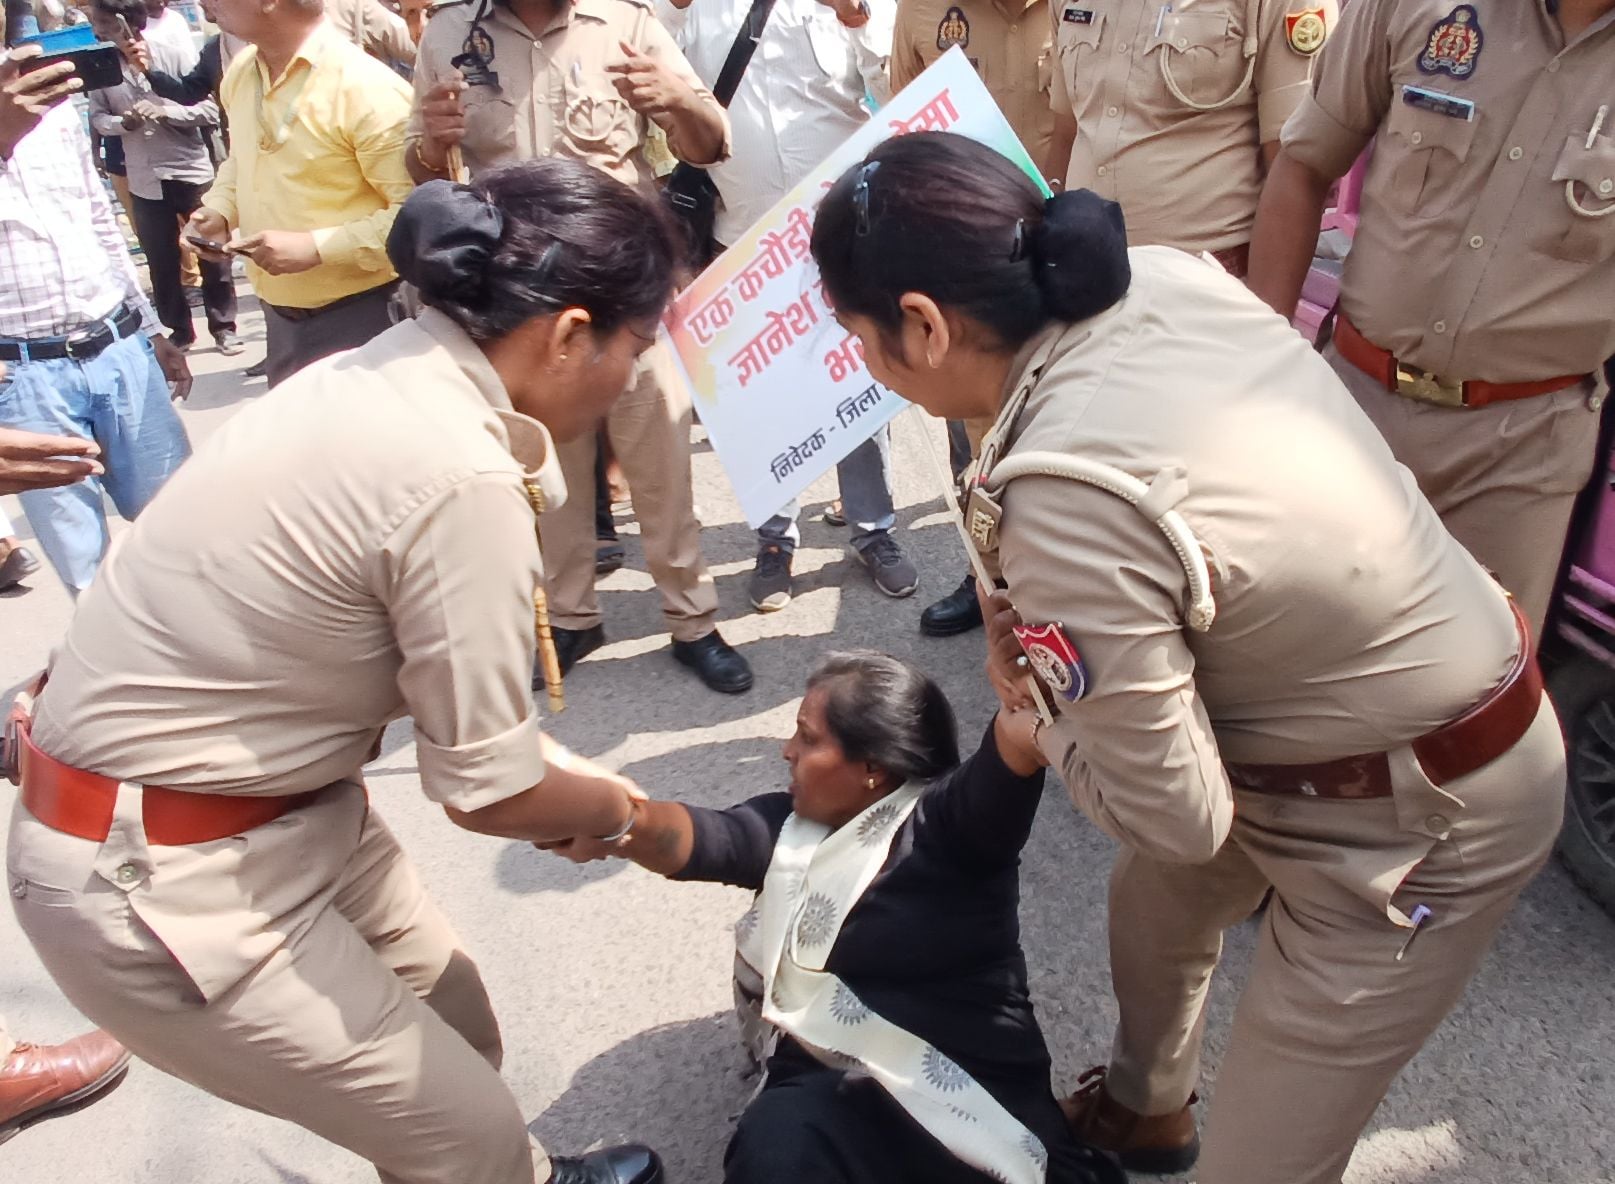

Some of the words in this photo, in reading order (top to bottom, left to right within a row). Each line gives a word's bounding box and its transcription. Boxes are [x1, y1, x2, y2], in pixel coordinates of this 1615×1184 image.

[688, 287, 735, 344] एक
[731, 207, 814, 302] कचौड़ी
[770, 427, 827, 484] निवेदक
[836, 382, 882, 429] जिला
